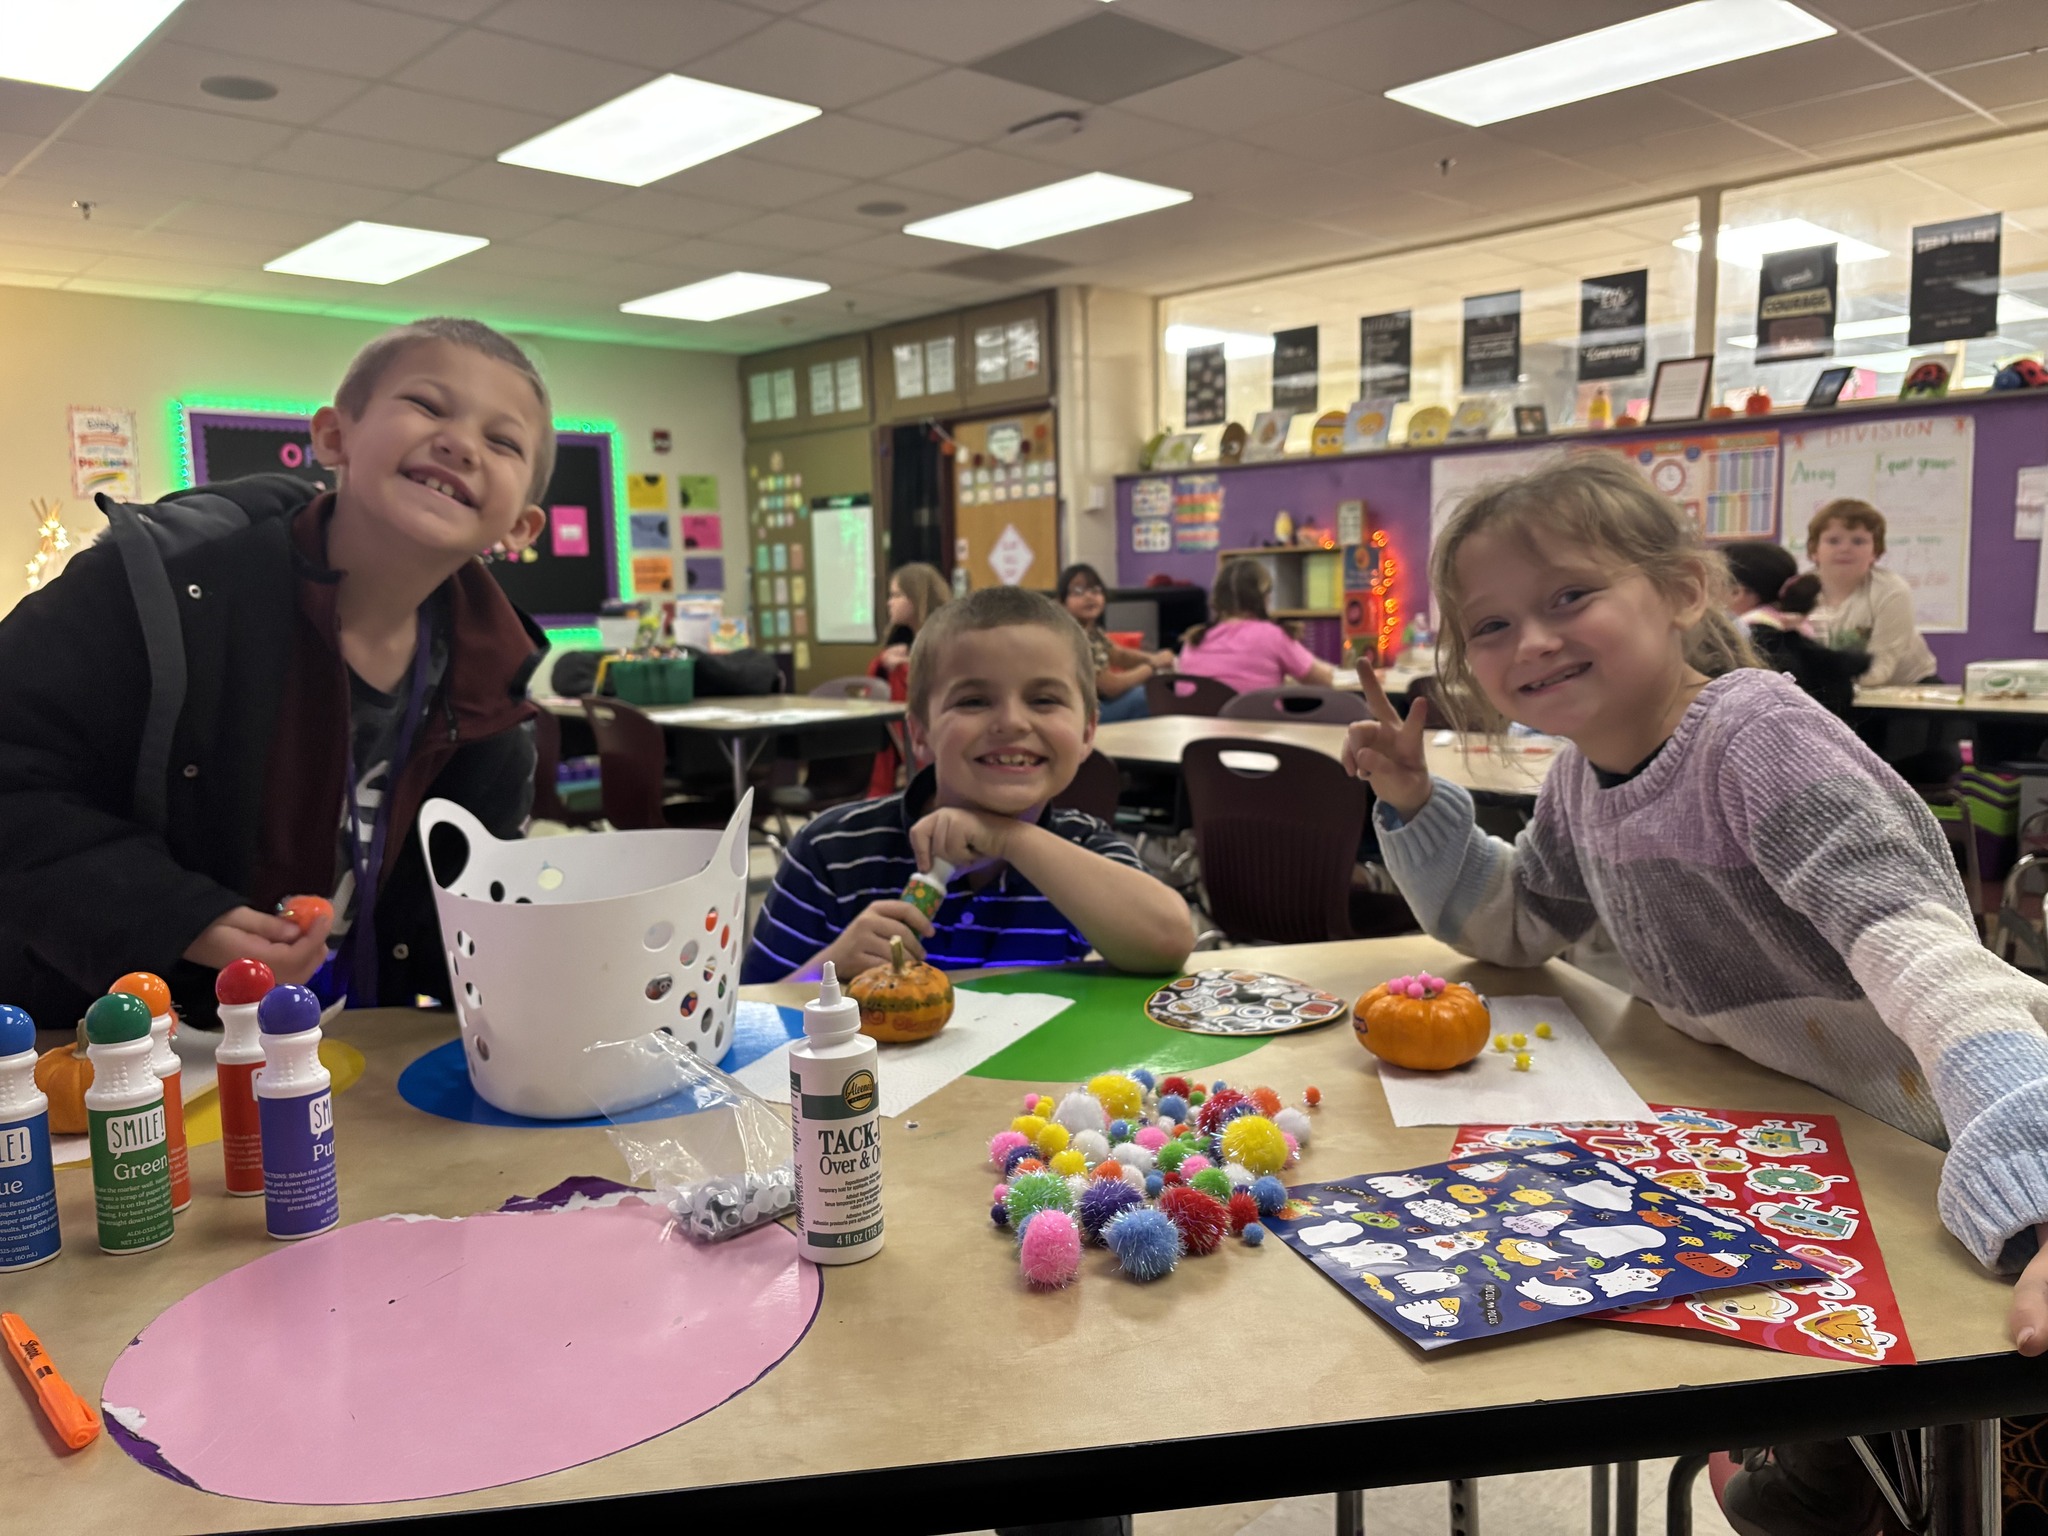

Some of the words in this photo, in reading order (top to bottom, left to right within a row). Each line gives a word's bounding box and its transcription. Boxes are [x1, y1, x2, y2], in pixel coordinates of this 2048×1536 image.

[1825, 420, 1934, 446] DIVISION
[1791, 460, 1837, 489] Array
[314, 1098, 331, 1129] SM
[111, 1110, 165, 1148] SMILE!
[114, 1154, 168, 1180] Green
[820, 1156, 857, 1175] Over
[860, 1151, 870, 1169] &
[872, 1145, 880, 1163] O
[10, 1197, 35, 1207] Remove
[27, 1204, 41, 1212] start
[22, 1222, 37, 1230] keep
[1511, 1223, 1530, 1231] BOO
[1516, 1216, 1548, 1230] LITTLE
[8, 1233, 28, 1241] create
[29, 1225, 50, 1237] colorful
[837, 1235, 842, 1245] 4
[845, 1234, 851, 1244] fl
[853, 1233, 863, 1242] oz
[864, 1226, 877, 1240] (118
[1485, 1284, 1496, 1302] HOCUS
[1487, 1307, 1499, 1324] POCUS
